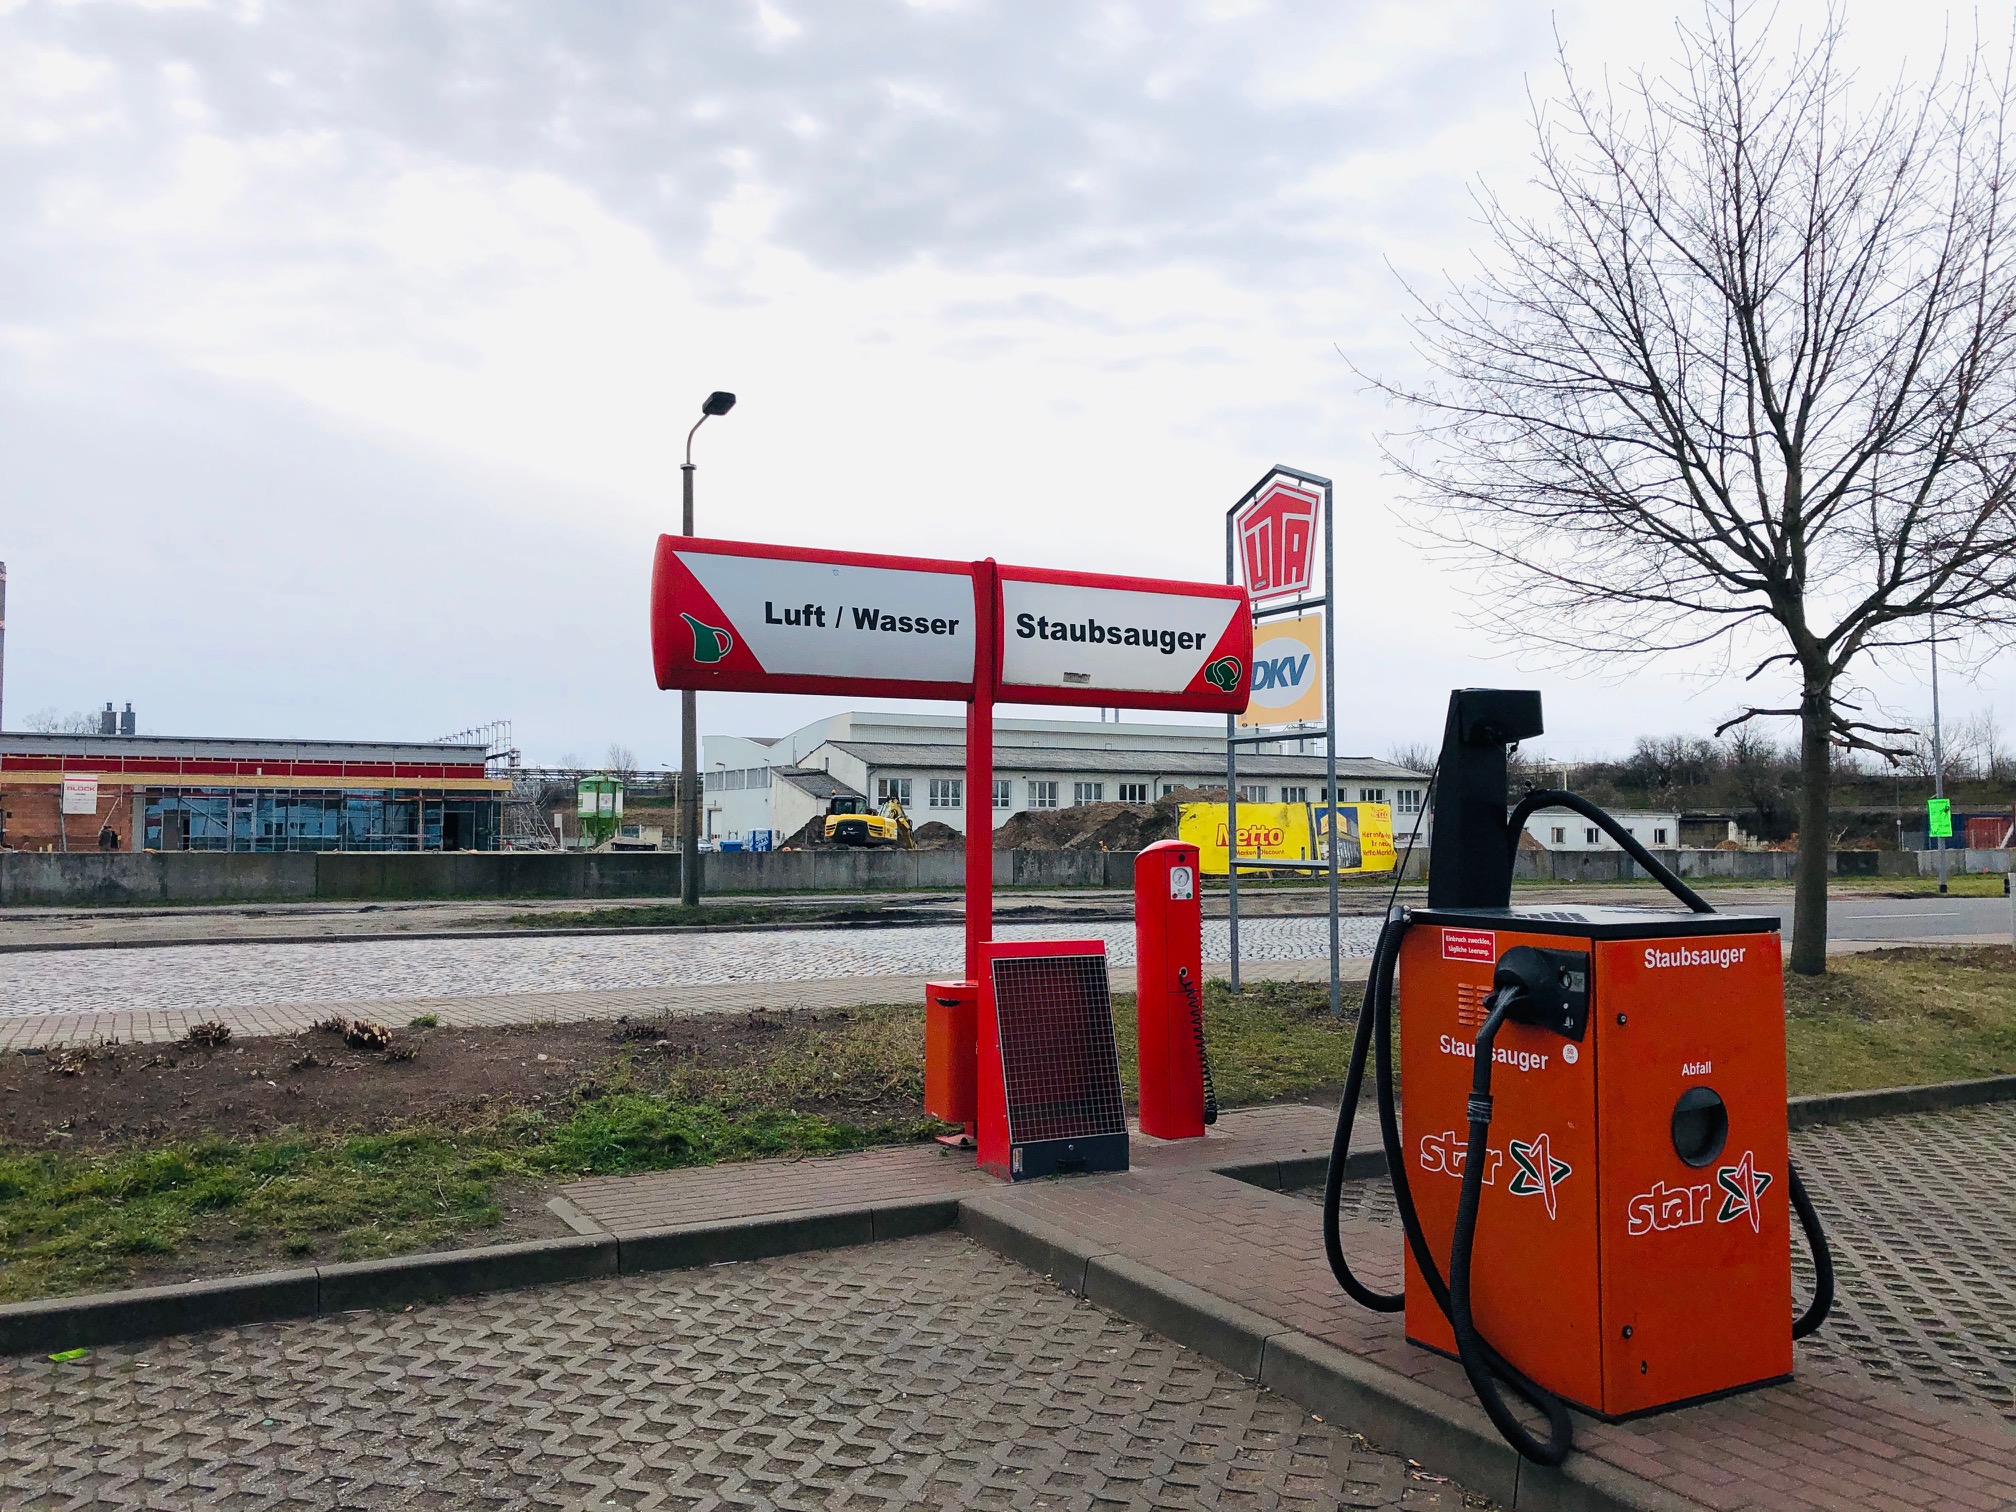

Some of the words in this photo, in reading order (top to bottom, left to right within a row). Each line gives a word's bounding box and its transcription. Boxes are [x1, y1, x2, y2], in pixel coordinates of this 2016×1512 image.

[1244, 491, 1312, 592] UTA
[765, 601, 826, 628] Luft
[835, 606, 843, 629] /
[852, 607, 959, 636] Wasser
[1016, 613, 1206, 655] Staubsauger
[1250, 653, 1311, 691] DKV
[1216, 823, 1285, 847] Netto
[1445, 935, 1466, 943] Einbruch
[1644, 946, 1746, 969] Staubsauger
[1440, 1034, 1548, 1072] Stauauger
[1681, 1060, 1712, 1076] Abfall
[1628, 1181, 1711, 1235] star
